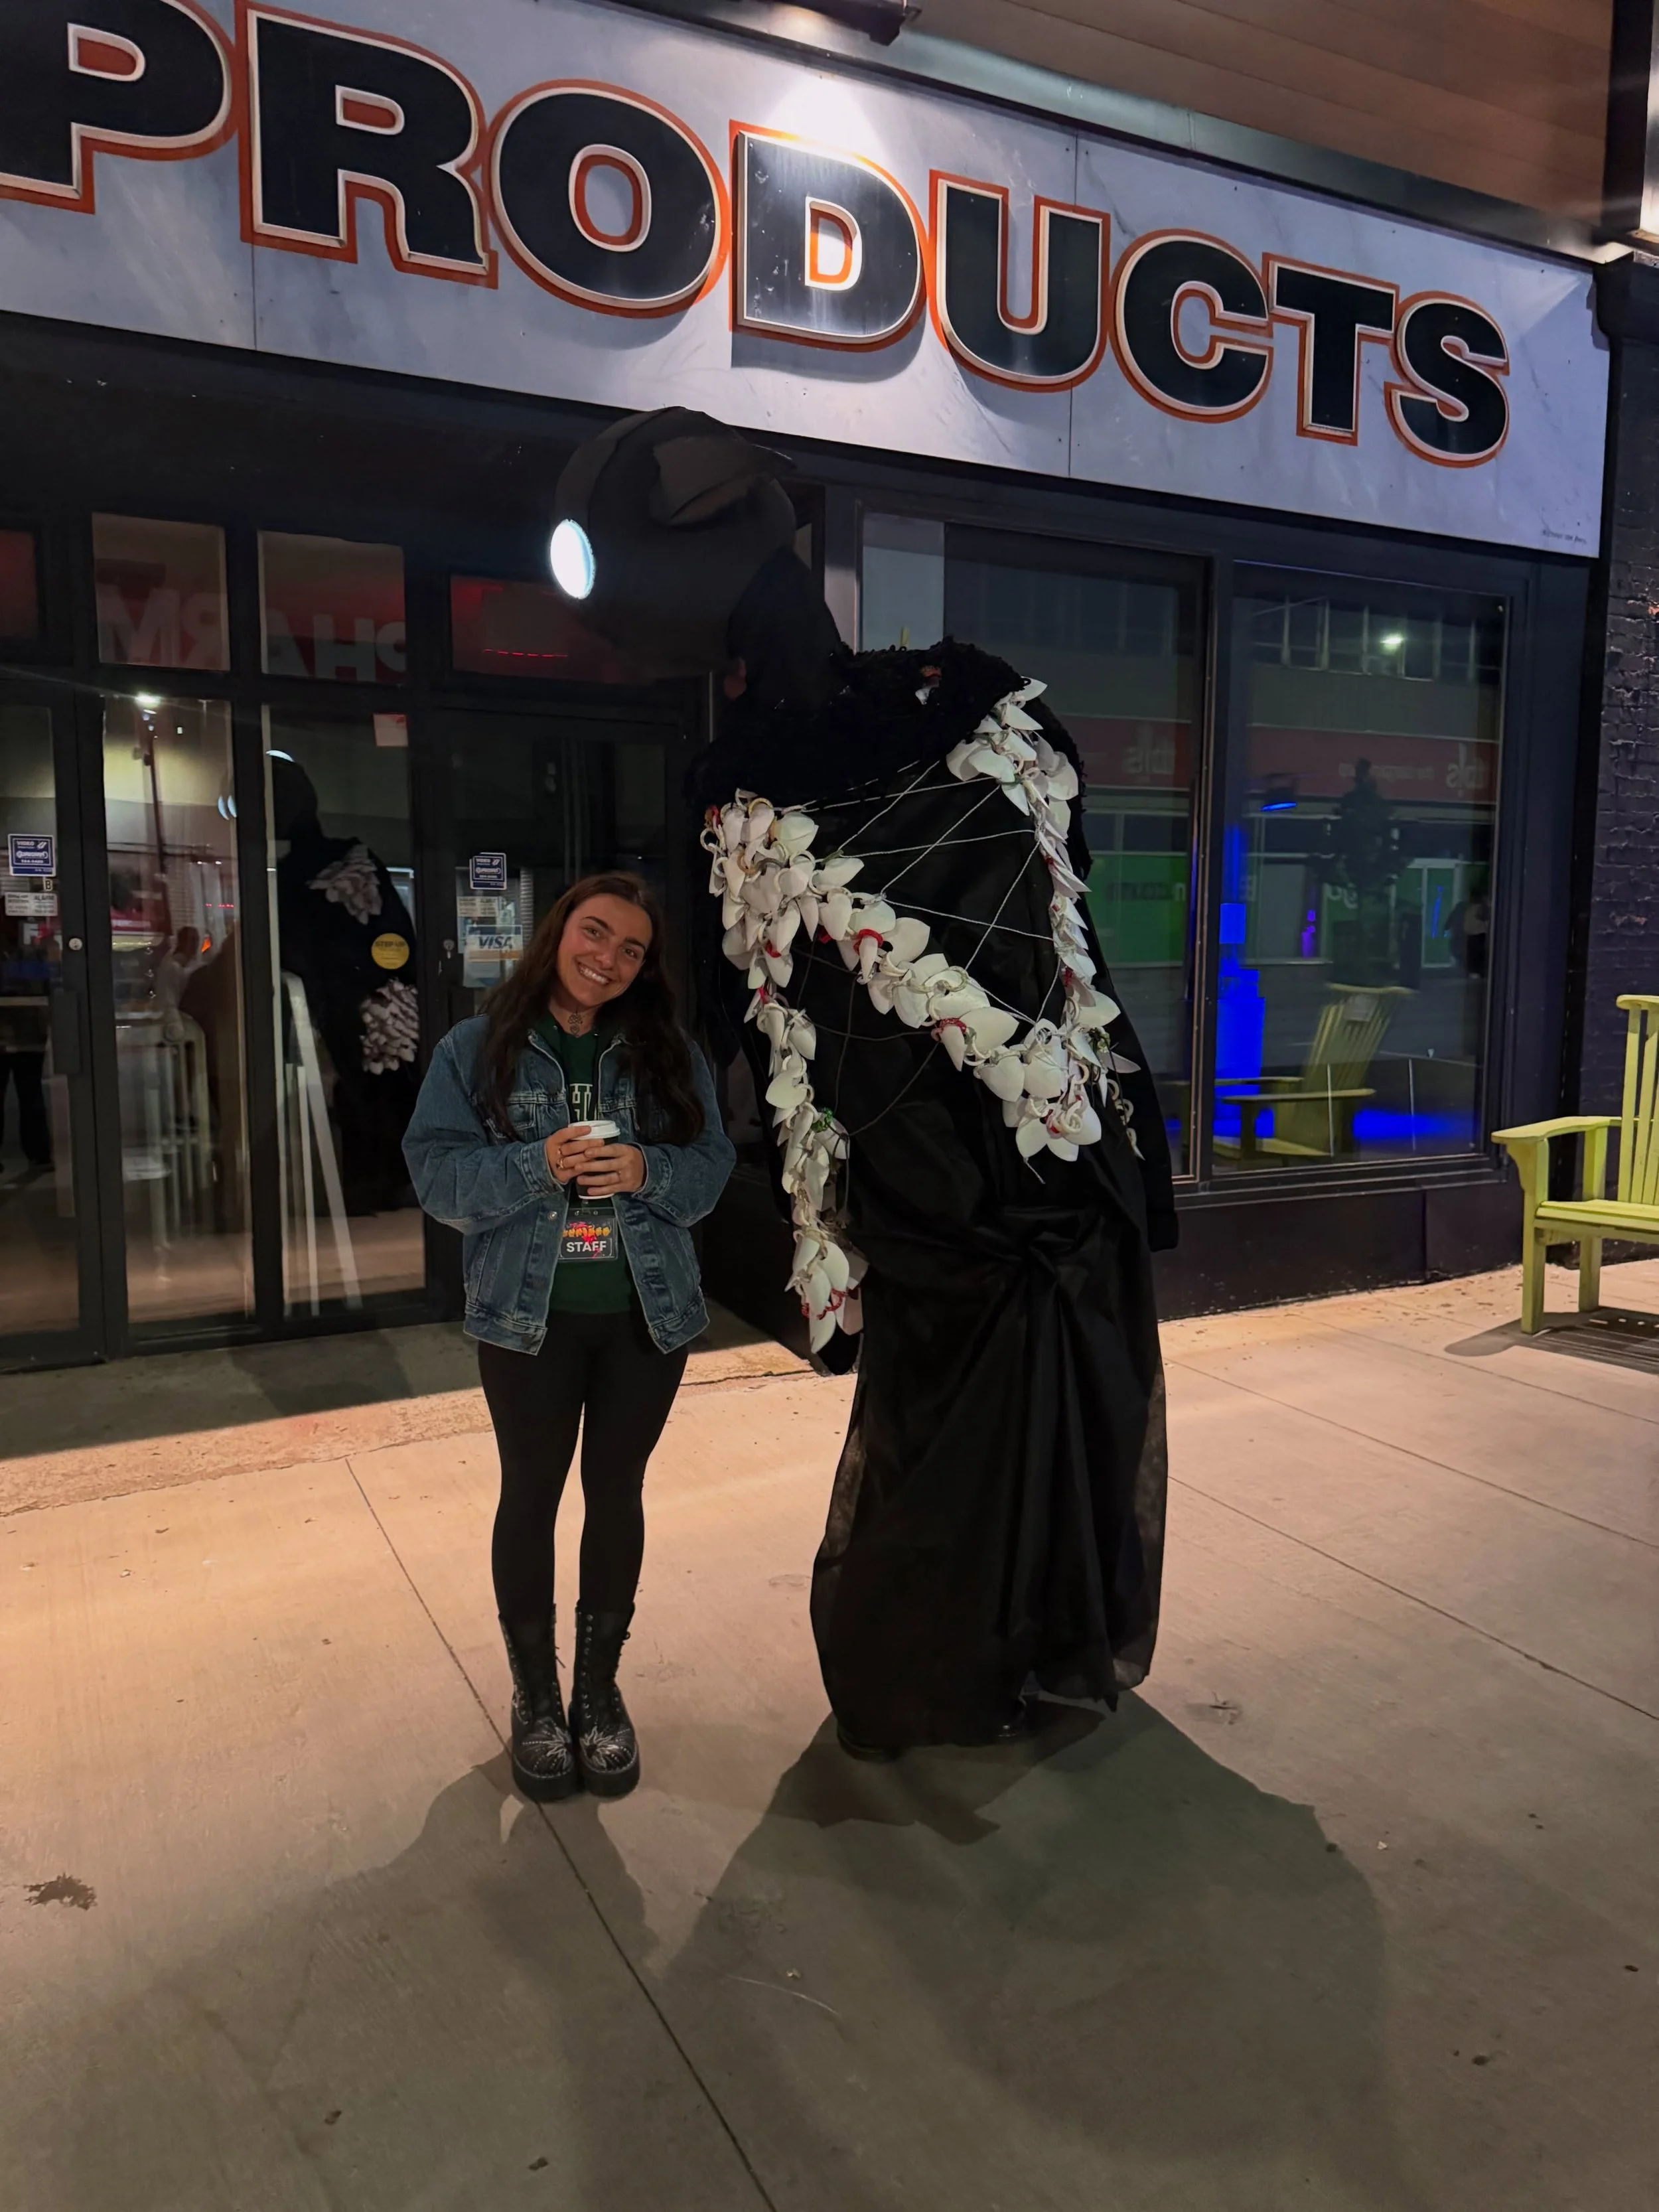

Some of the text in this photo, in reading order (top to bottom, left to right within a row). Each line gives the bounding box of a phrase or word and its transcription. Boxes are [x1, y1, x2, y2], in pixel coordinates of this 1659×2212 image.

[0, 0, 1510, 468] PRODUCTS
[478, 936, 513, 949] VISA
[566, 1240, 607, 1253] STAFF
